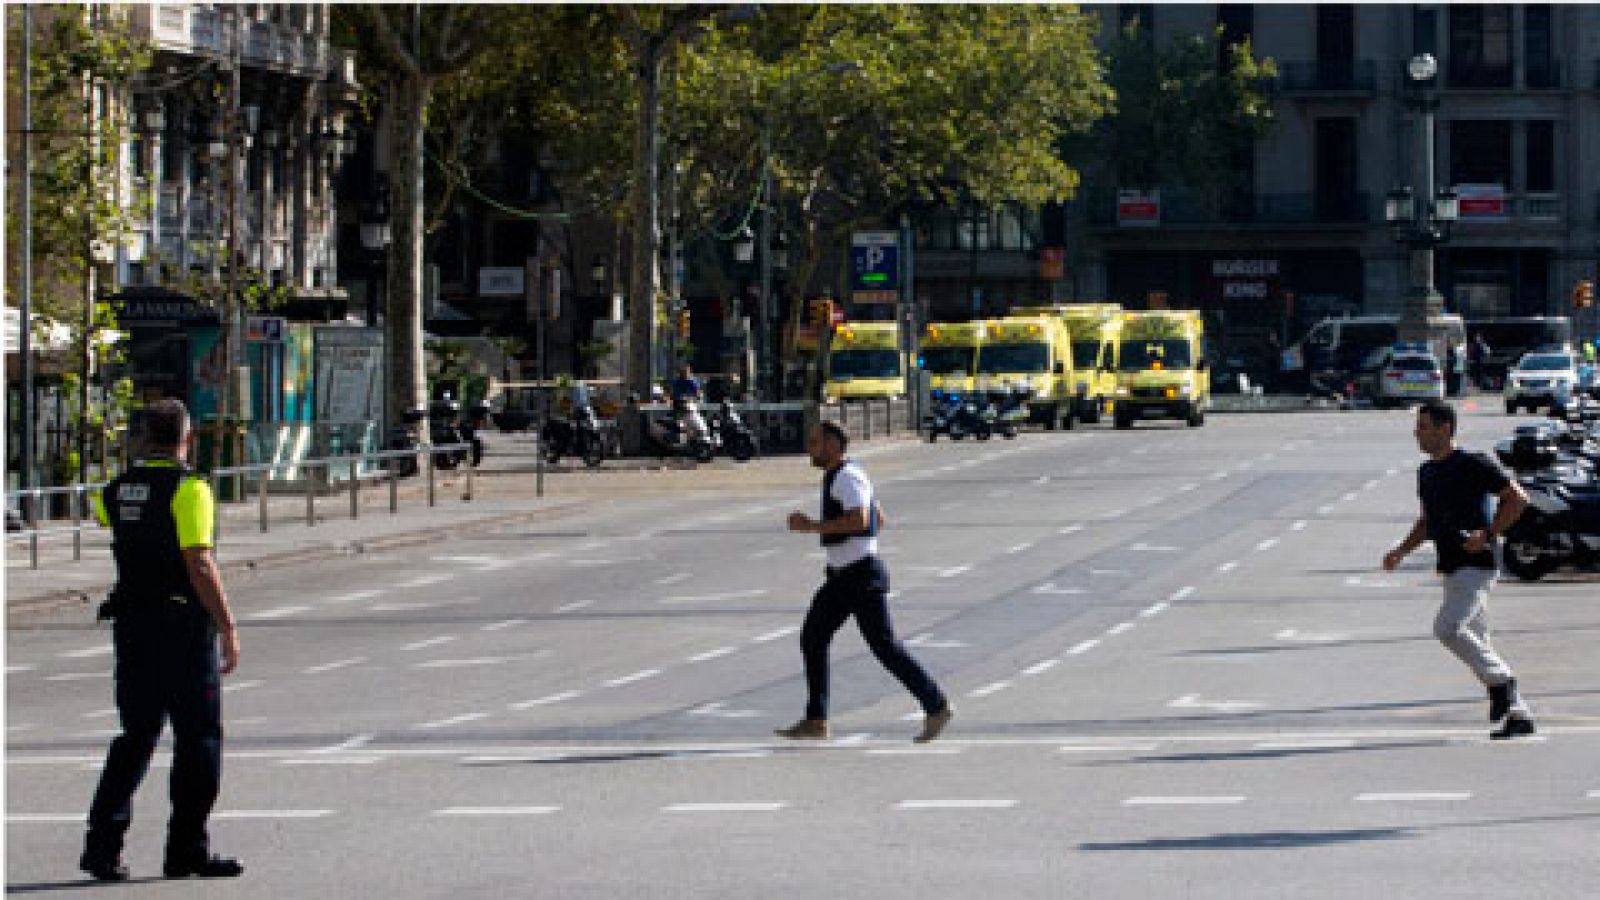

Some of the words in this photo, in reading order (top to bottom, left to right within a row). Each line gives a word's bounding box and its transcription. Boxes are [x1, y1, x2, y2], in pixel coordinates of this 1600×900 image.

[866, 247, 884, 272] P
[1212, 260, 1279, 276] BURGER
[1223, 281, 1267, 298] KING
